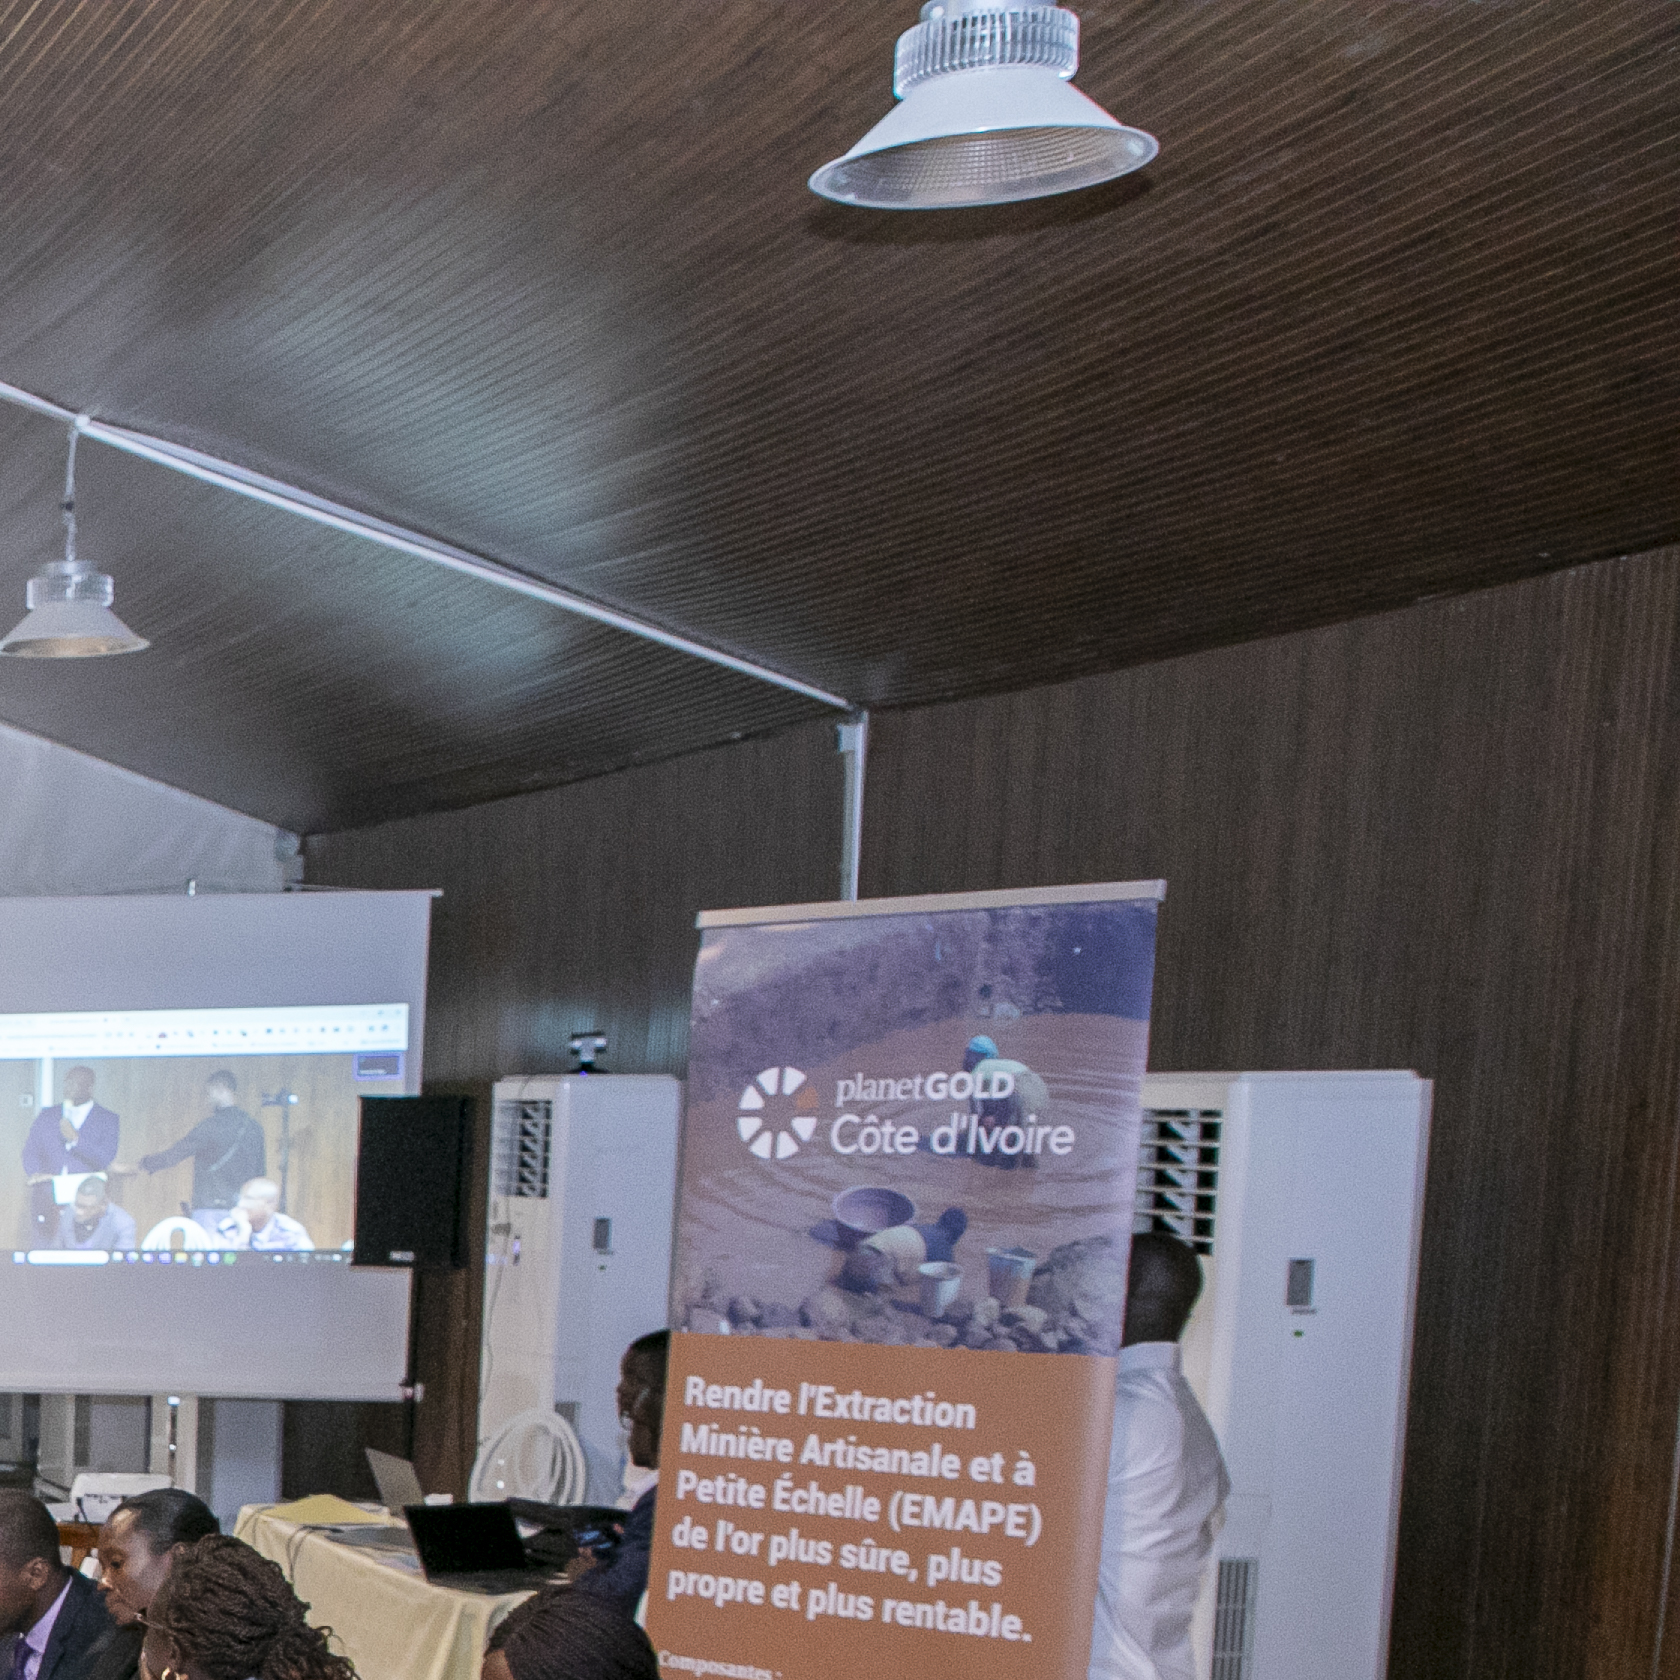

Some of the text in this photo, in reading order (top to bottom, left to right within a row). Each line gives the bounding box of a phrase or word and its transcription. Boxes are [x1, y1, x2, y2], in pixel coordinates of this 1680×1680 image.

[835, 1070, 1015, 1107] planetGOLD
[830, 1111, 1076, 1155] Côte d'Ivoire
[684, 1375, 977, 1430] Rendre l'Extraction
[680, 1422, 1036, 1487] Minière Artisanale et à
[676, 1469, 1042, 1547] Petite Échelle (EMAPE)
[671, 1515, 1004, 1588] de l'or plus sûre, plus
[666, 1568, 1033, 1643] propre et plus rentable.
